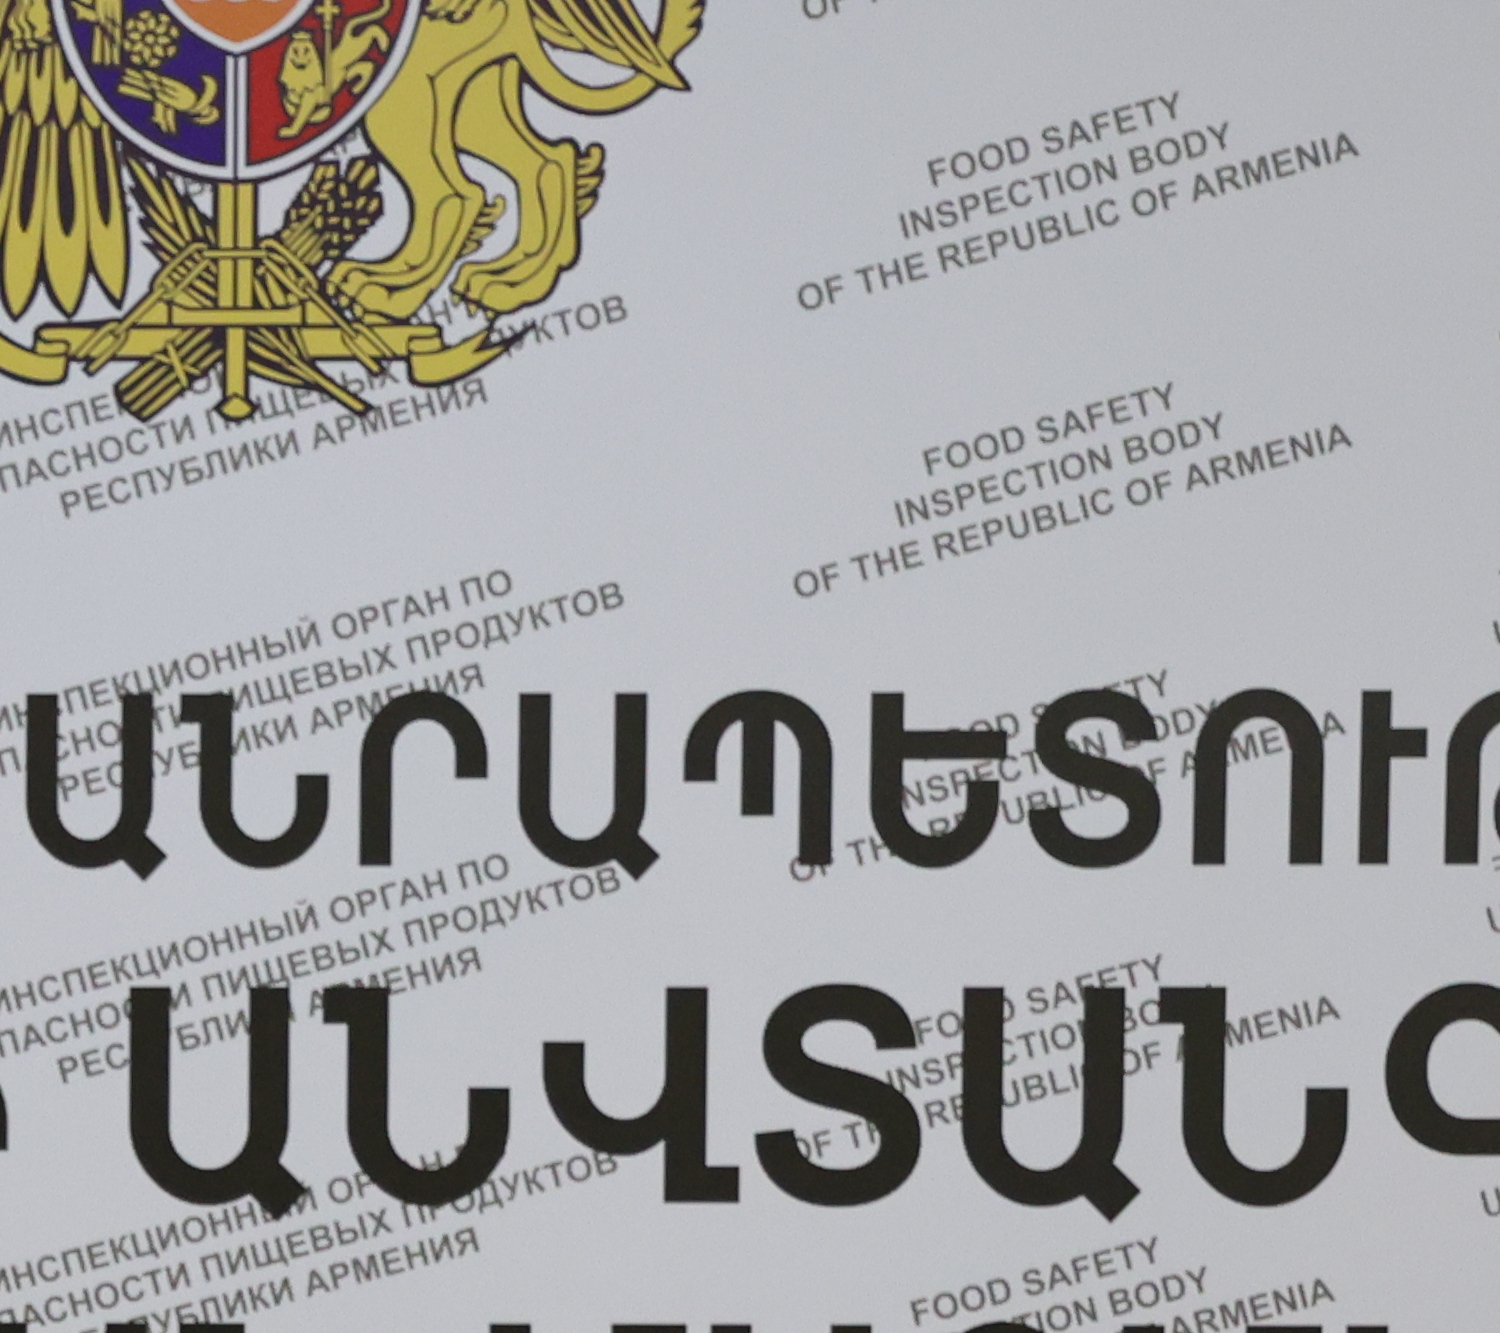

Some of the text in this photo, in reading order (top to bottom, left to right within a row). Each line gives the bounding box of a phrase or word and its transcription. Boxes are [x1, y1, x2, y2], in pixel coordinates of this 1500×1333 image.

[899, 122, 1228, 239] INSPECTION BODY
[927, 91, 1178, 187] FOOD SAFETY
[797, 132, 1359, 310] OF THE REPUBLIC OF ARMENIA
[60, 430, 300, 518] РЕСПУБЛИКИ
[895, 412, 1222, 527] INSPECTION BODY
[923, 382, 1172, 476] FOOD SAFETY
[793, 424, 1352, 598] OF THE REPUBLIC OF ARMENIA
[329, 870, 447, 923] ОРГАН
[457, 854, 509, 889] ПО
[403, 872, 621, 946] ПРОДУКТОВ
